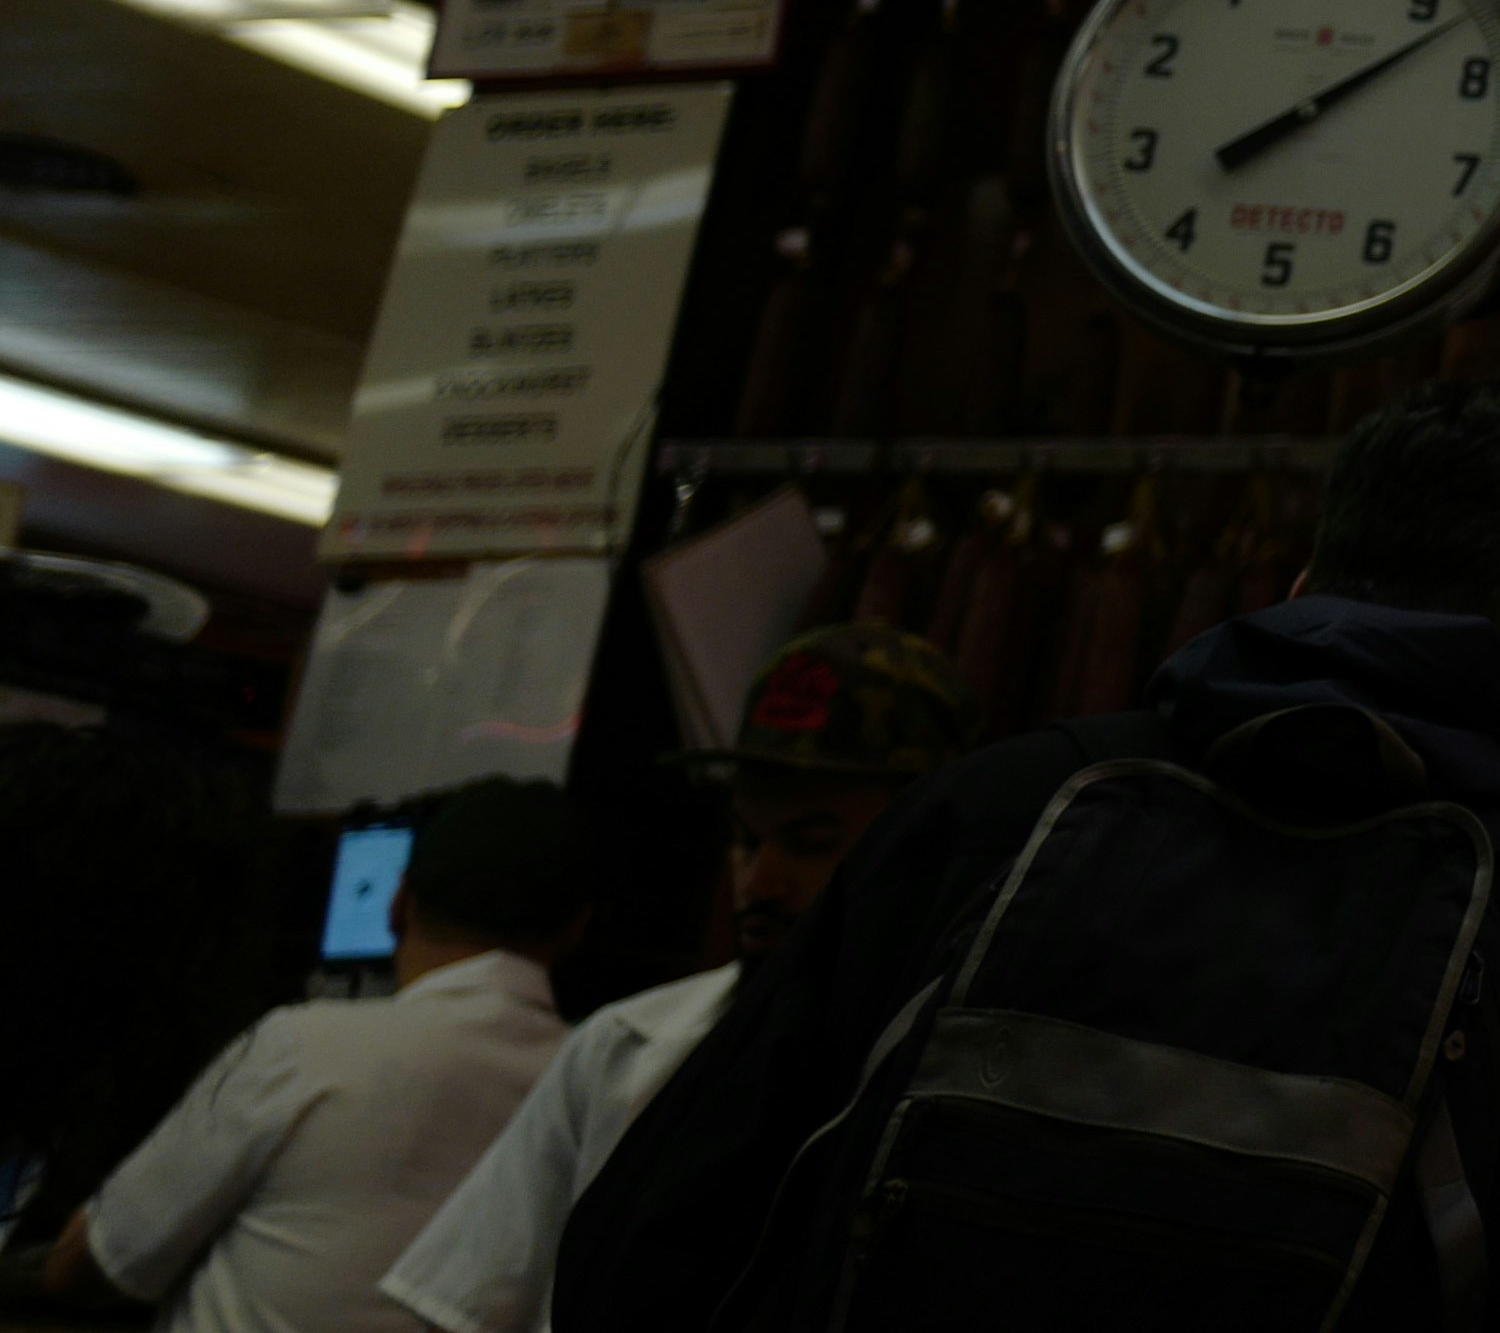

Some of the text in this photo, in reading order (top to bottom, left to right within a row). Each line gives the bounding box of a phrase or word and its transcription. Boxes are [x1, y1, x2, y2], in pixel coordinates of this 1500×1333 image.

[1144, 34, 1180, 80] 2
[1458, 57, 1491, 102] 8
[1123, 129, 1160, 174] 3
[1450, 153, 1482, 199] 7
[1165, 208, 1199, 254] 4
[1362, 219, 1398, 265] 6
[1260, 242, 1295, 288] 5
